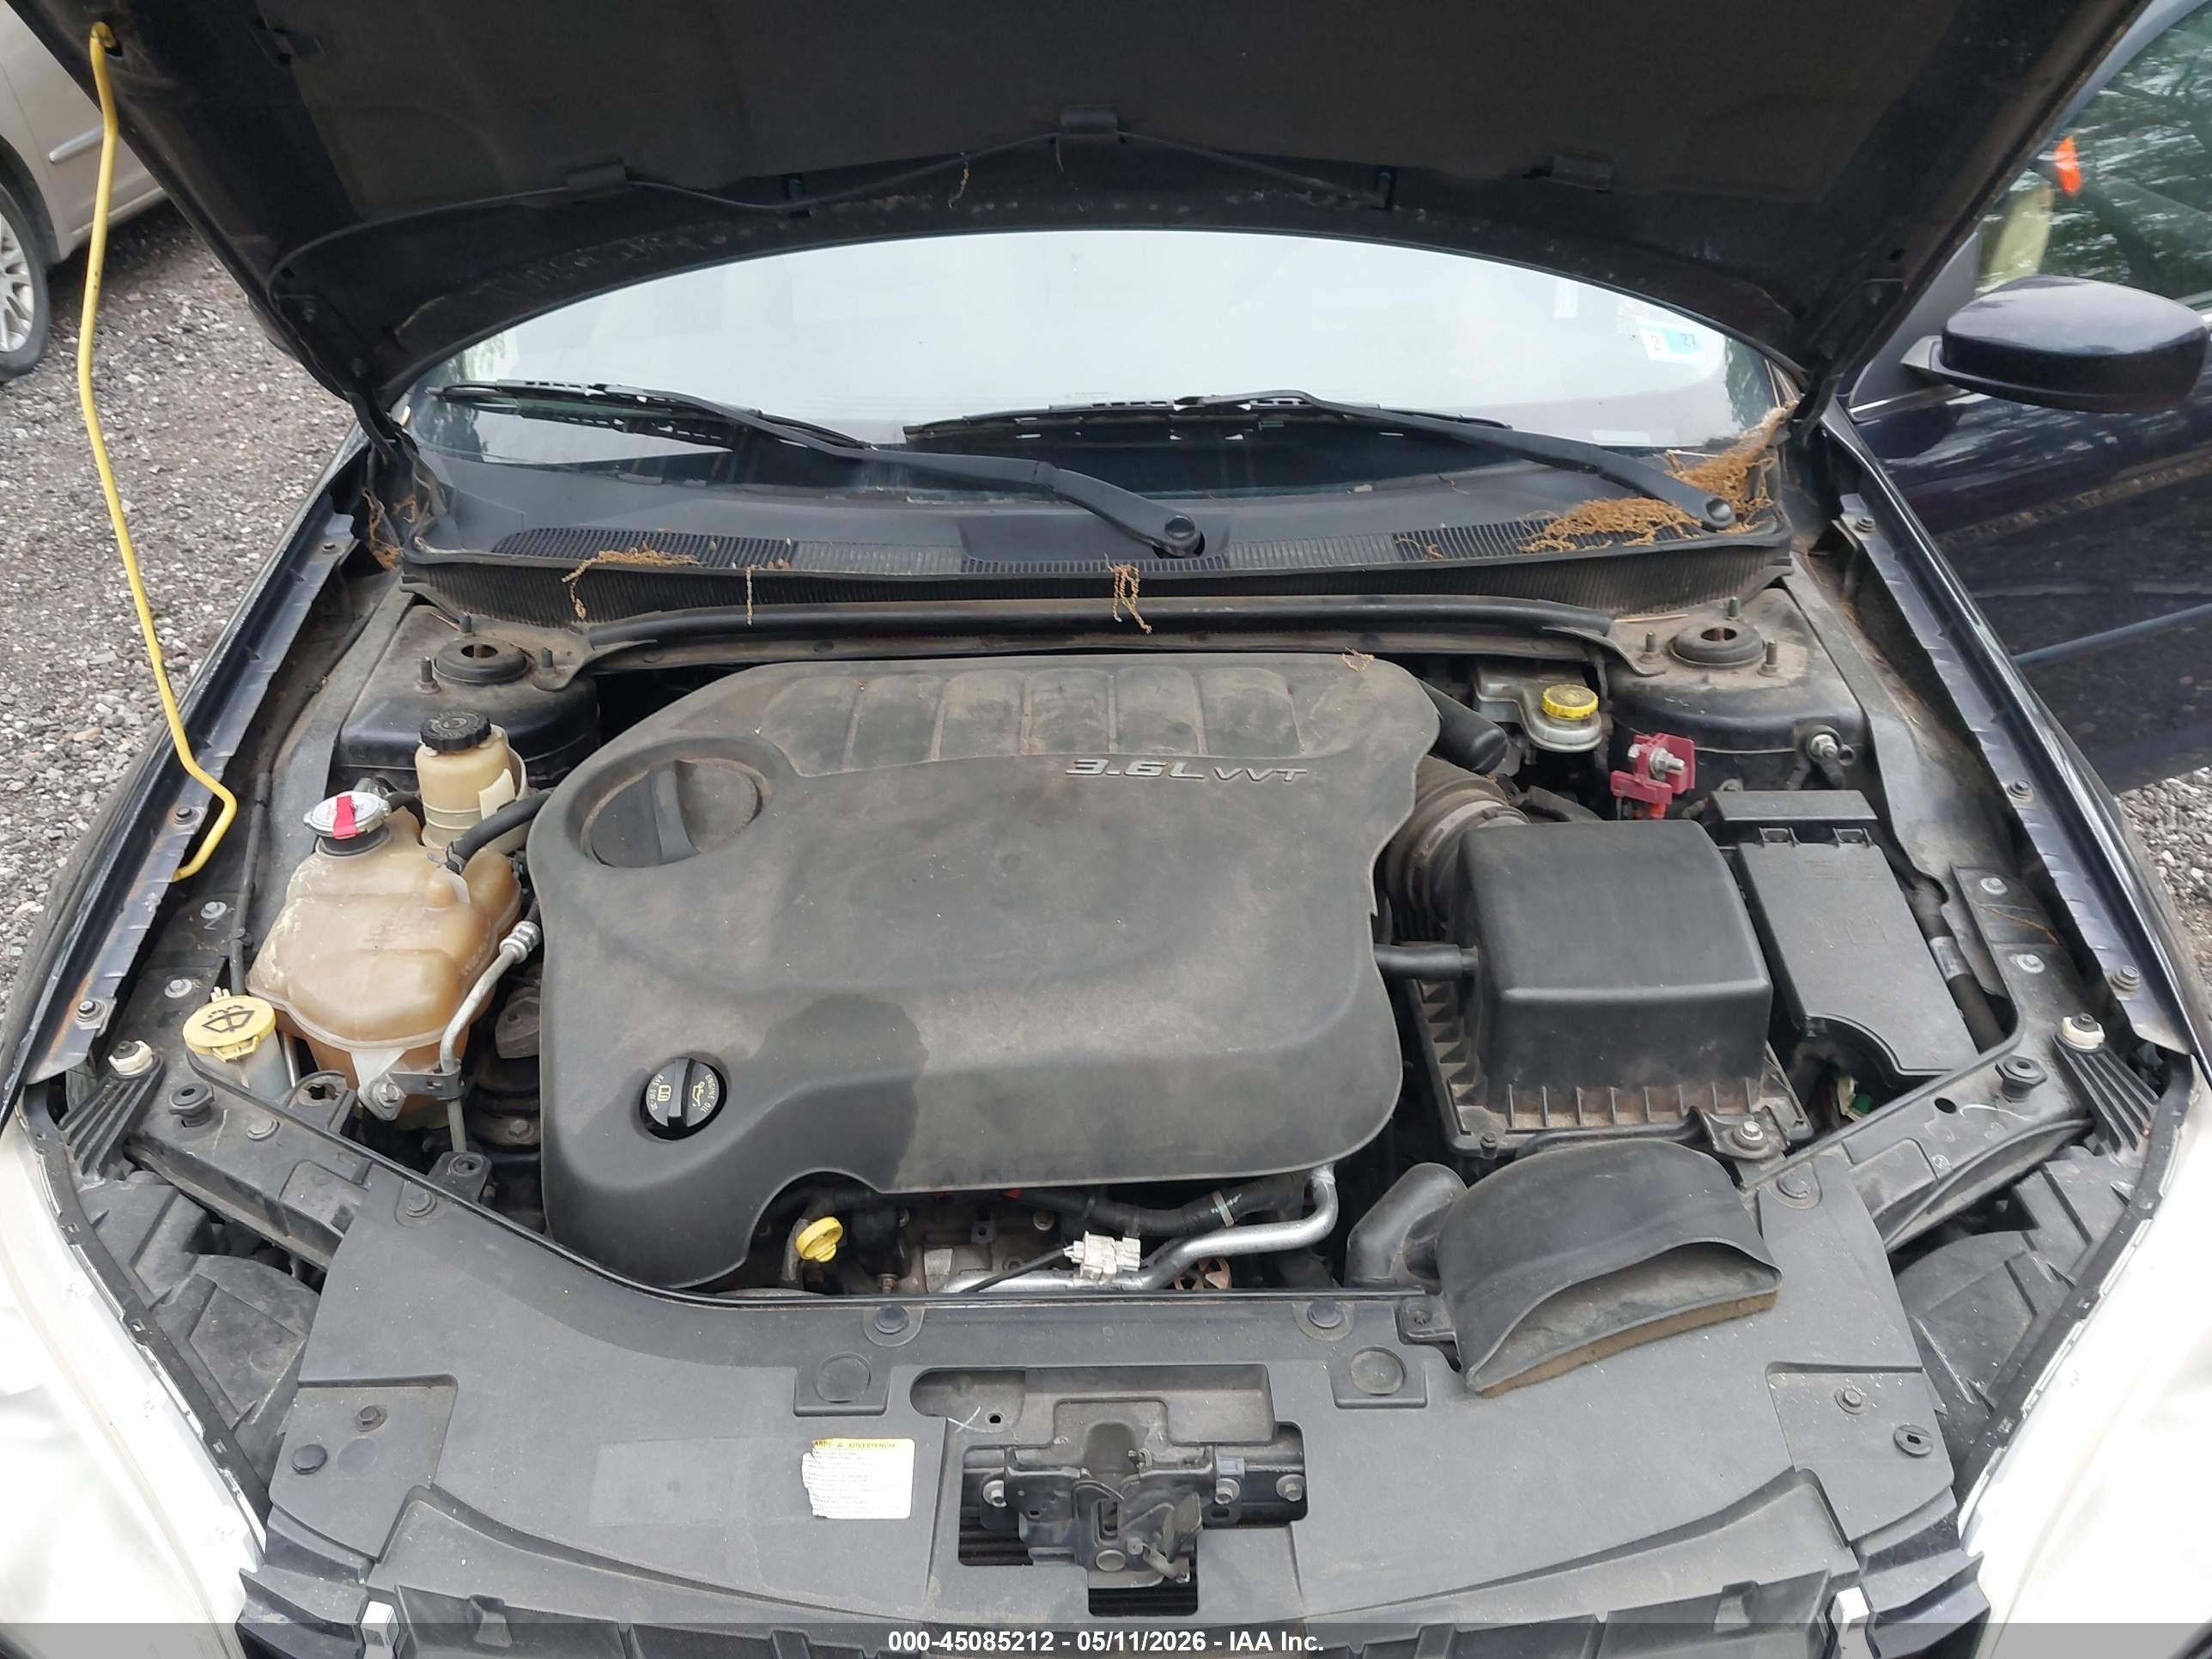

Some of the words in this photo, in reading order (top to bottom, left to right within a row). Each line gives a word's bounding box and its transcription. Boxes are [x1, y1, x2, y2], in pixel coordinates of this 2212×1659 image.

[1065, 758, 1204, 780] 3.6L
[1213, 767, 1308, 782] VVT
[705, 1073, 715, 1100] ENGINE
[700, 1102, 712, 1113] OIL
